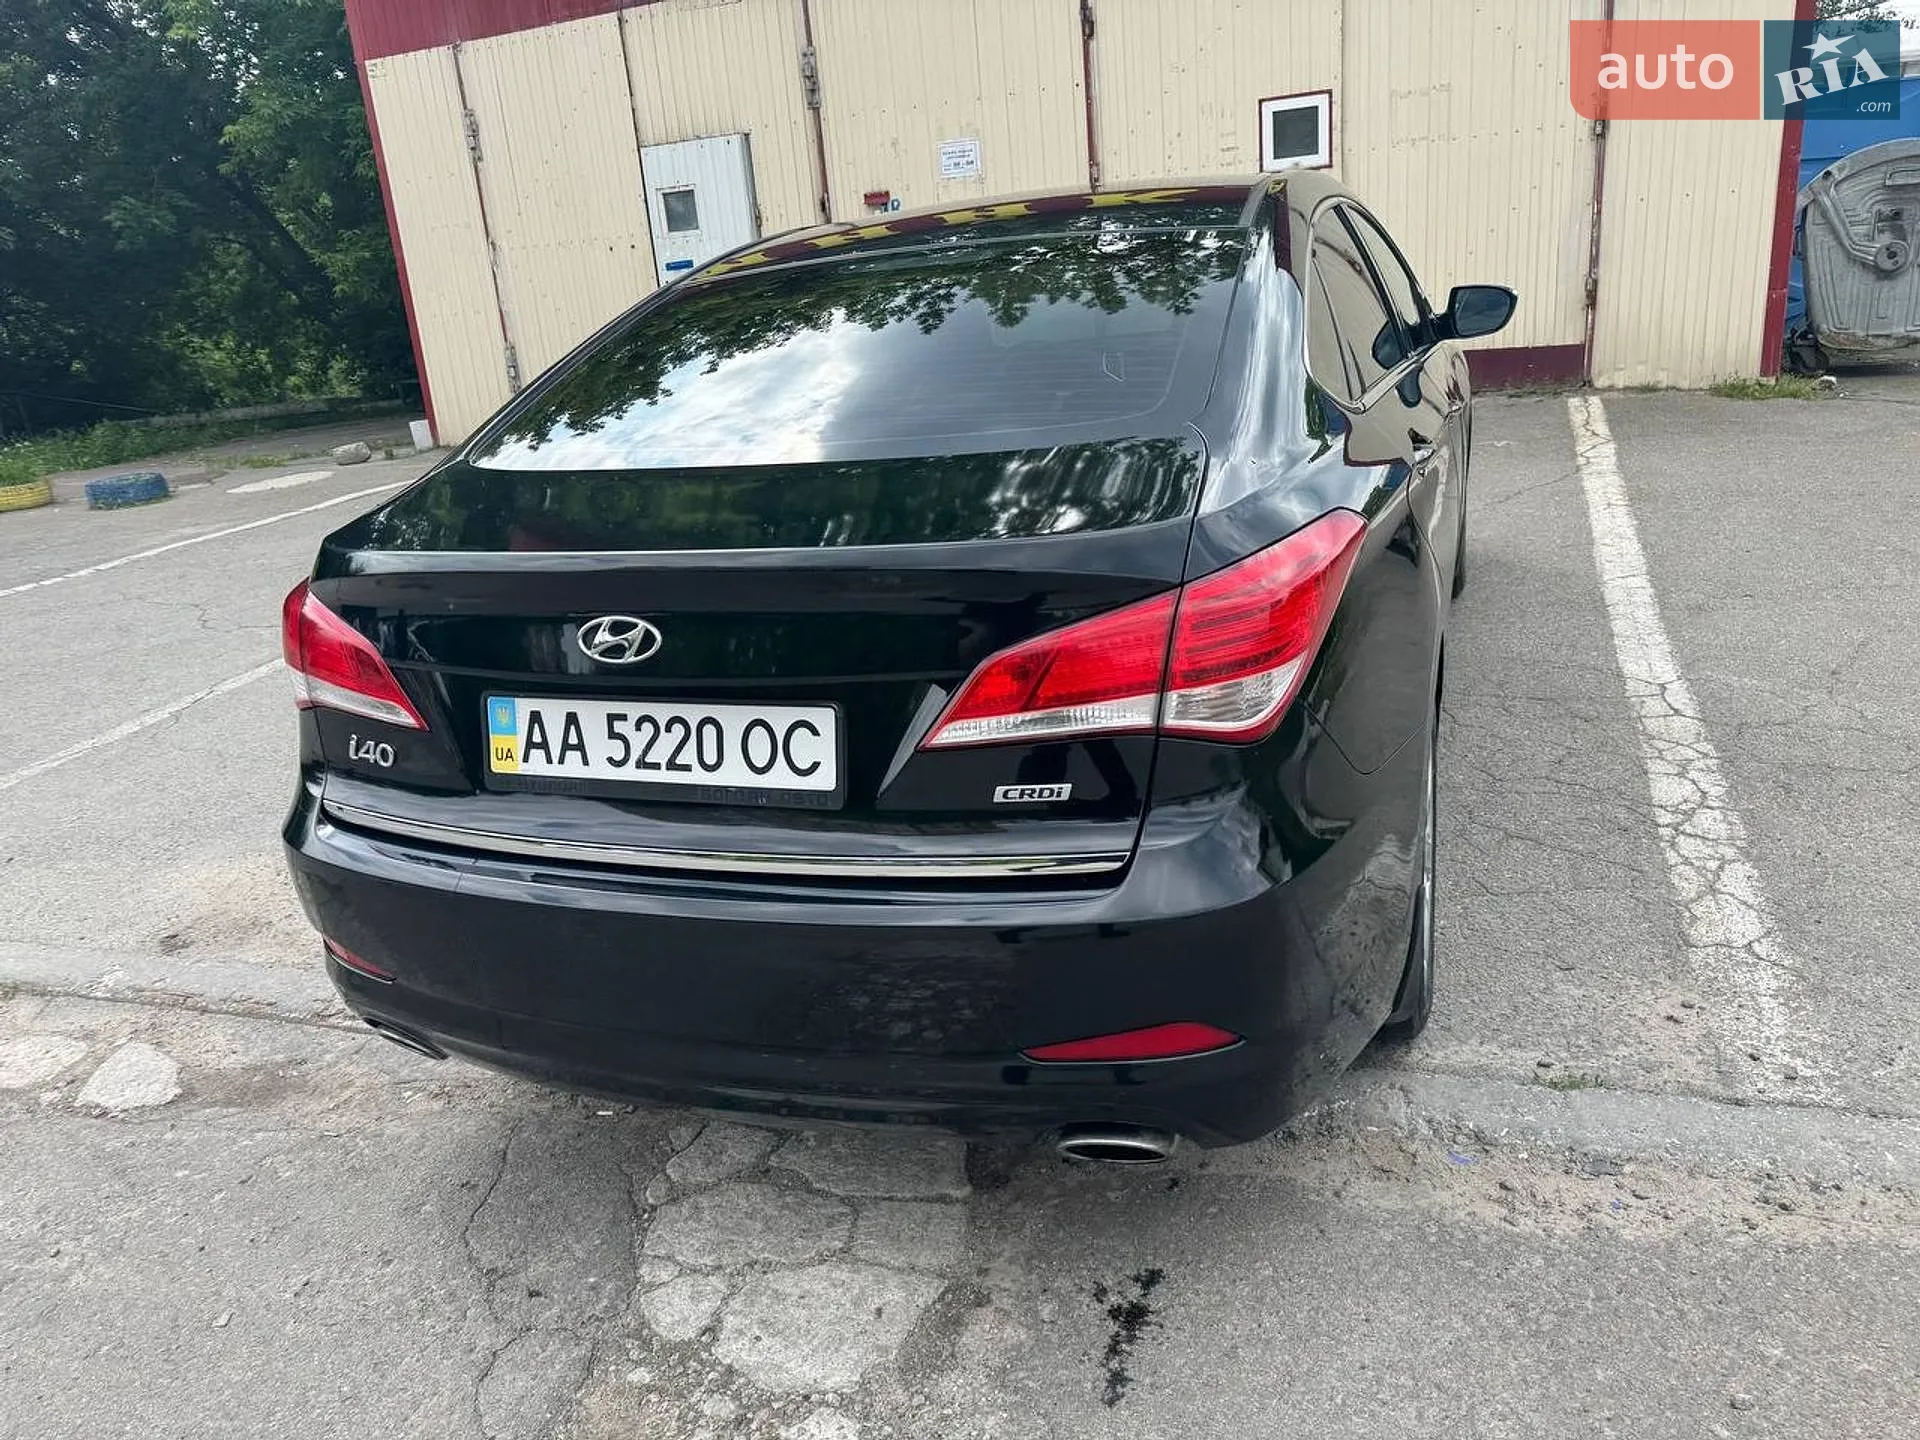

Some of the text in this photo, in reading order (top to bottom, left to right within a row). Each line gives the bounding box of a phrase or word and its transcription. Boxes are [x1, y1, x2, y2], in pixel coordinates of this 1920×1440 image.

[349, 734, 394, 767] i40
[495, 747, 515, 763] UA
[522, 710, 821, 777] AA 5220 OC
[1002, 786, 1064, 800] CRDi
